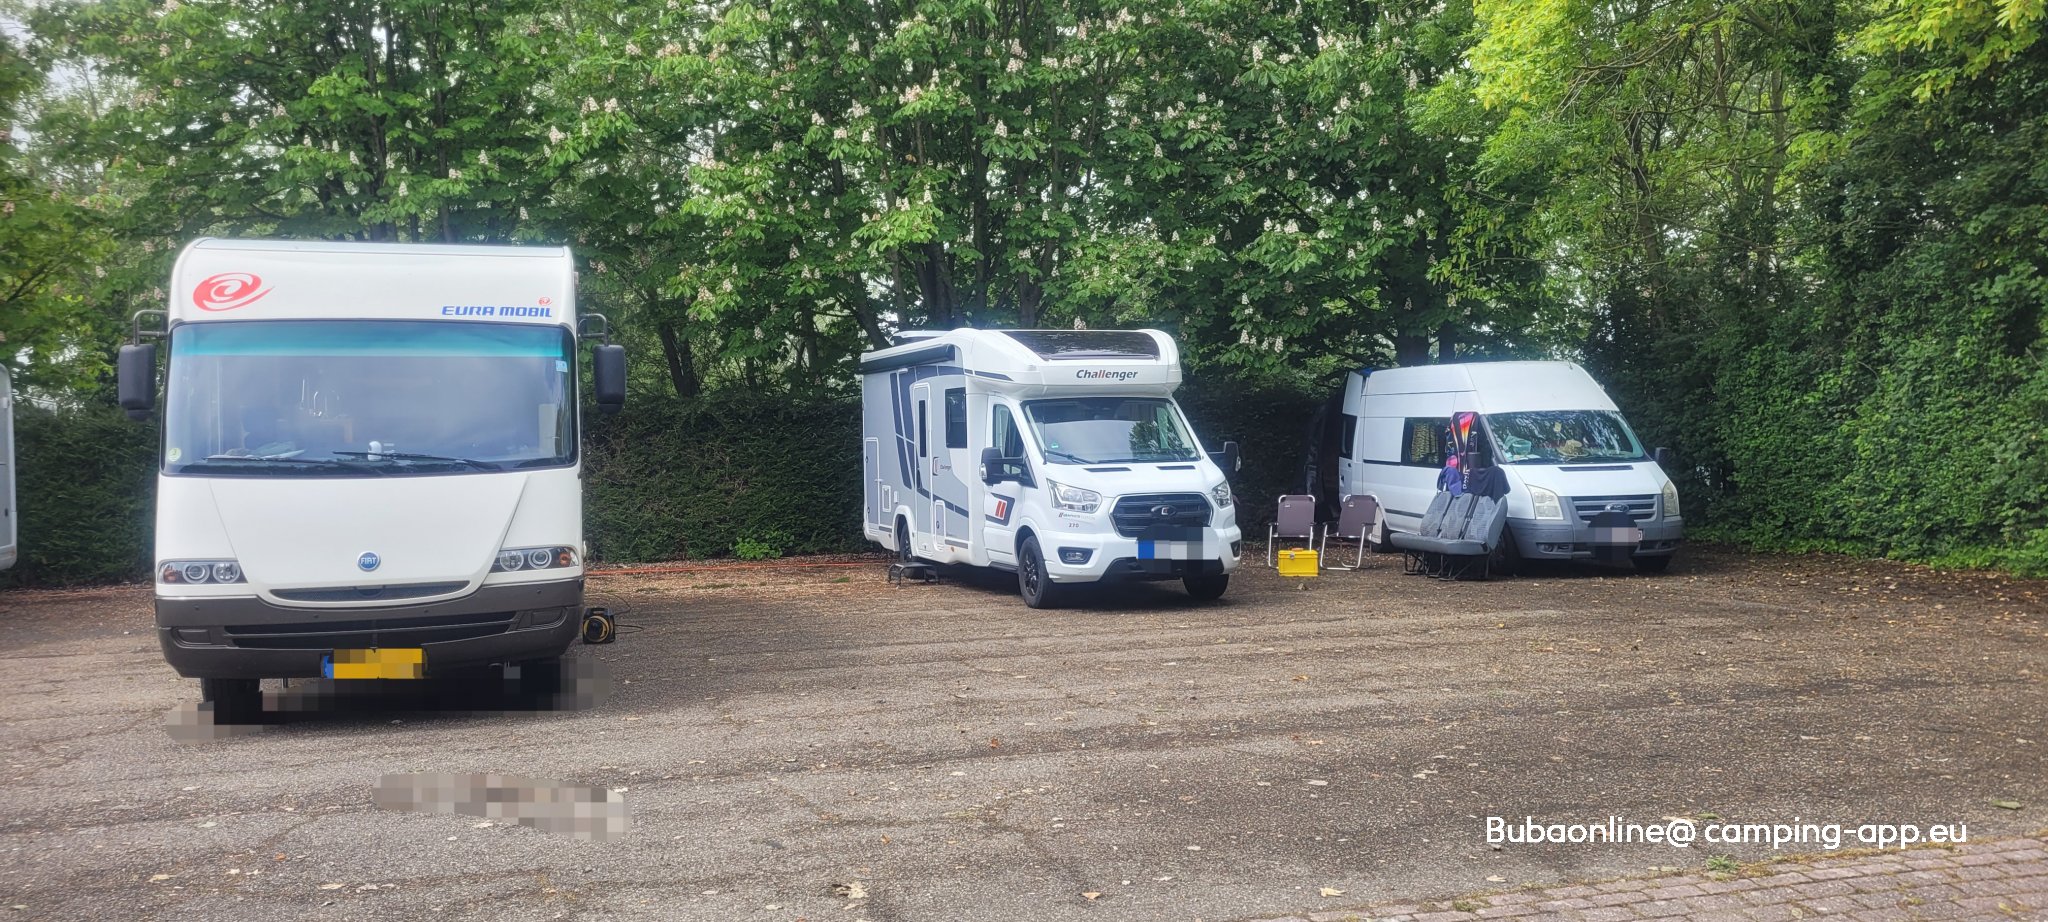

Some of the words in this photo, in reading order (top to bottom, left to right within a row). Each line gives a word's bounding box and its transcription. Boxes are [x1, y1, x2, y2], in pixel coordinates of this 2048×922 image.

[441, 305, 495, 316] EURA
[499, 306, 553, 318] MOBIL
[1076, 369, 1138, 381] Challenger
[360, 557, 377, 565] FIAT
